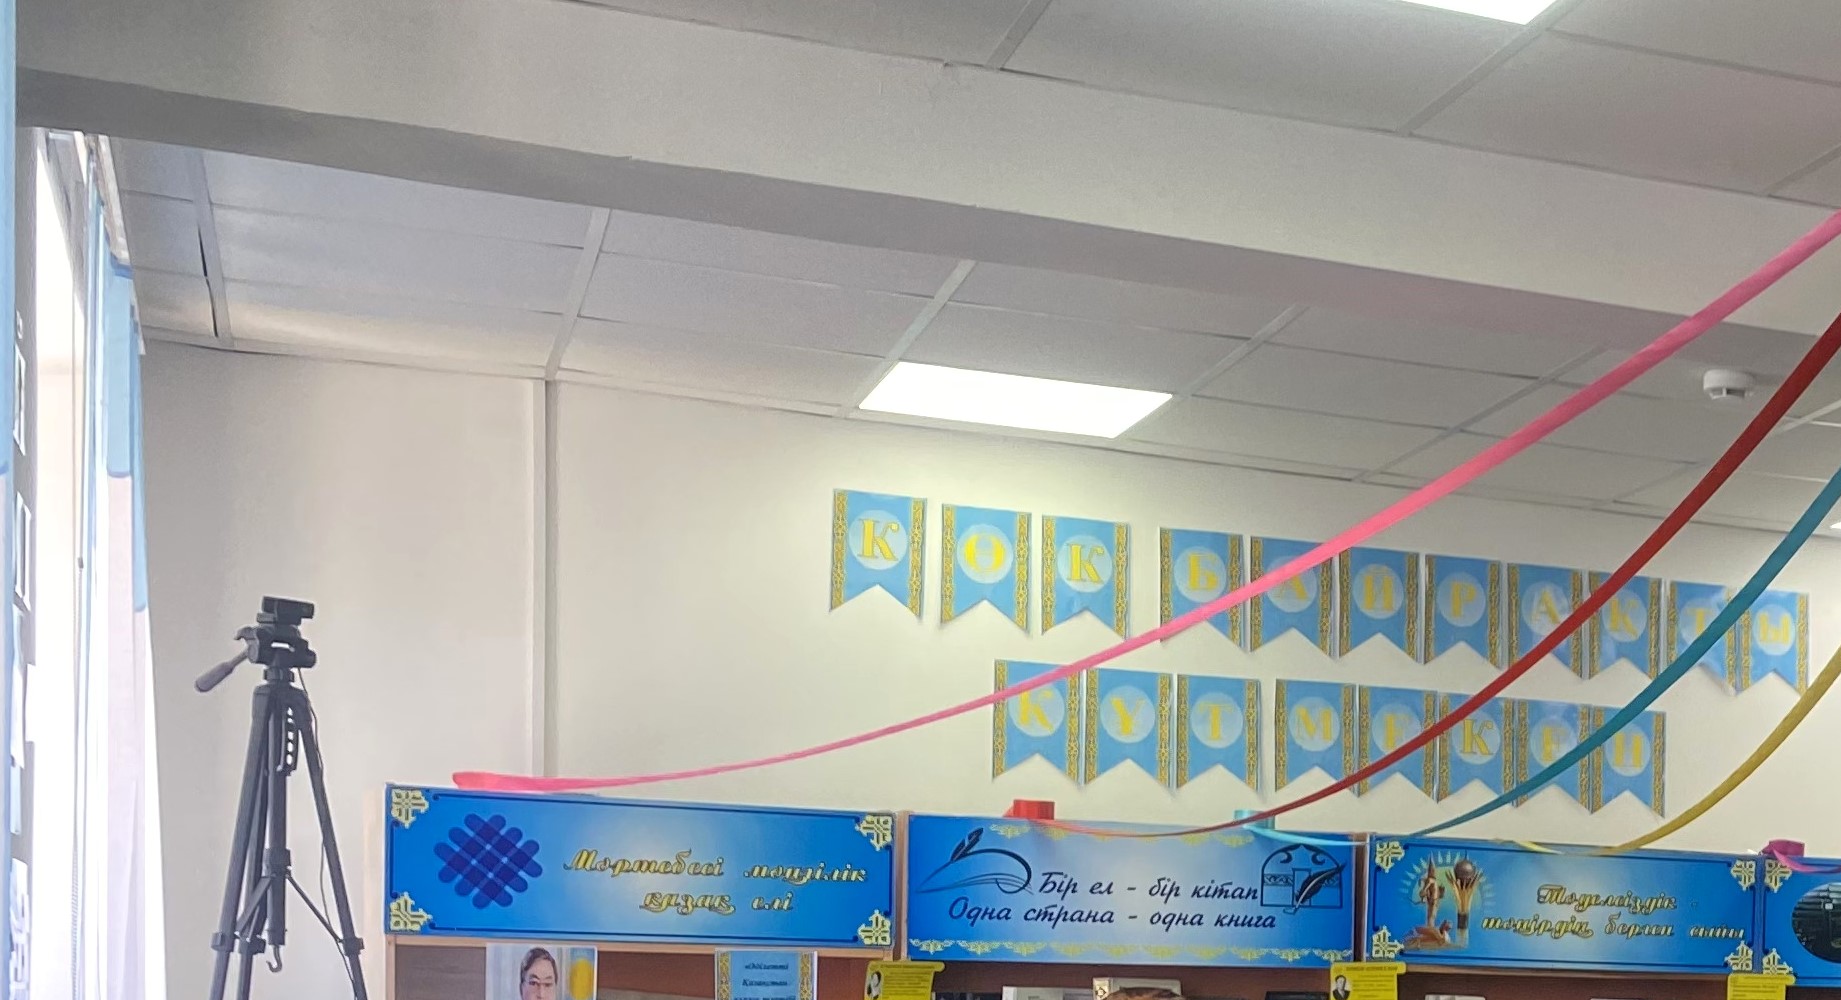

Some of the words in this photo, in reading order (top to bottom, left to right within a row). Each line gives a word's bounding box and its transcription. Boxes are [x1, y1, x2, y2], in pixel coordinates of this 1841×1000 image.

[1038, 870, 1079, 900] Бір
[1089, 879, 1113, 895] ел
[1149, 870, 1181, 900] бір
[1191, 878, 1259, 901] кітап
[1536, 883, 1678, 915] Тәуелсіздік
[948, 896, 1012, 928] Одна
[1023, 907, 1115, 930] страна
[1149, 909, 1204, 936] одна
[1213, 914, 1276, 930] книга
